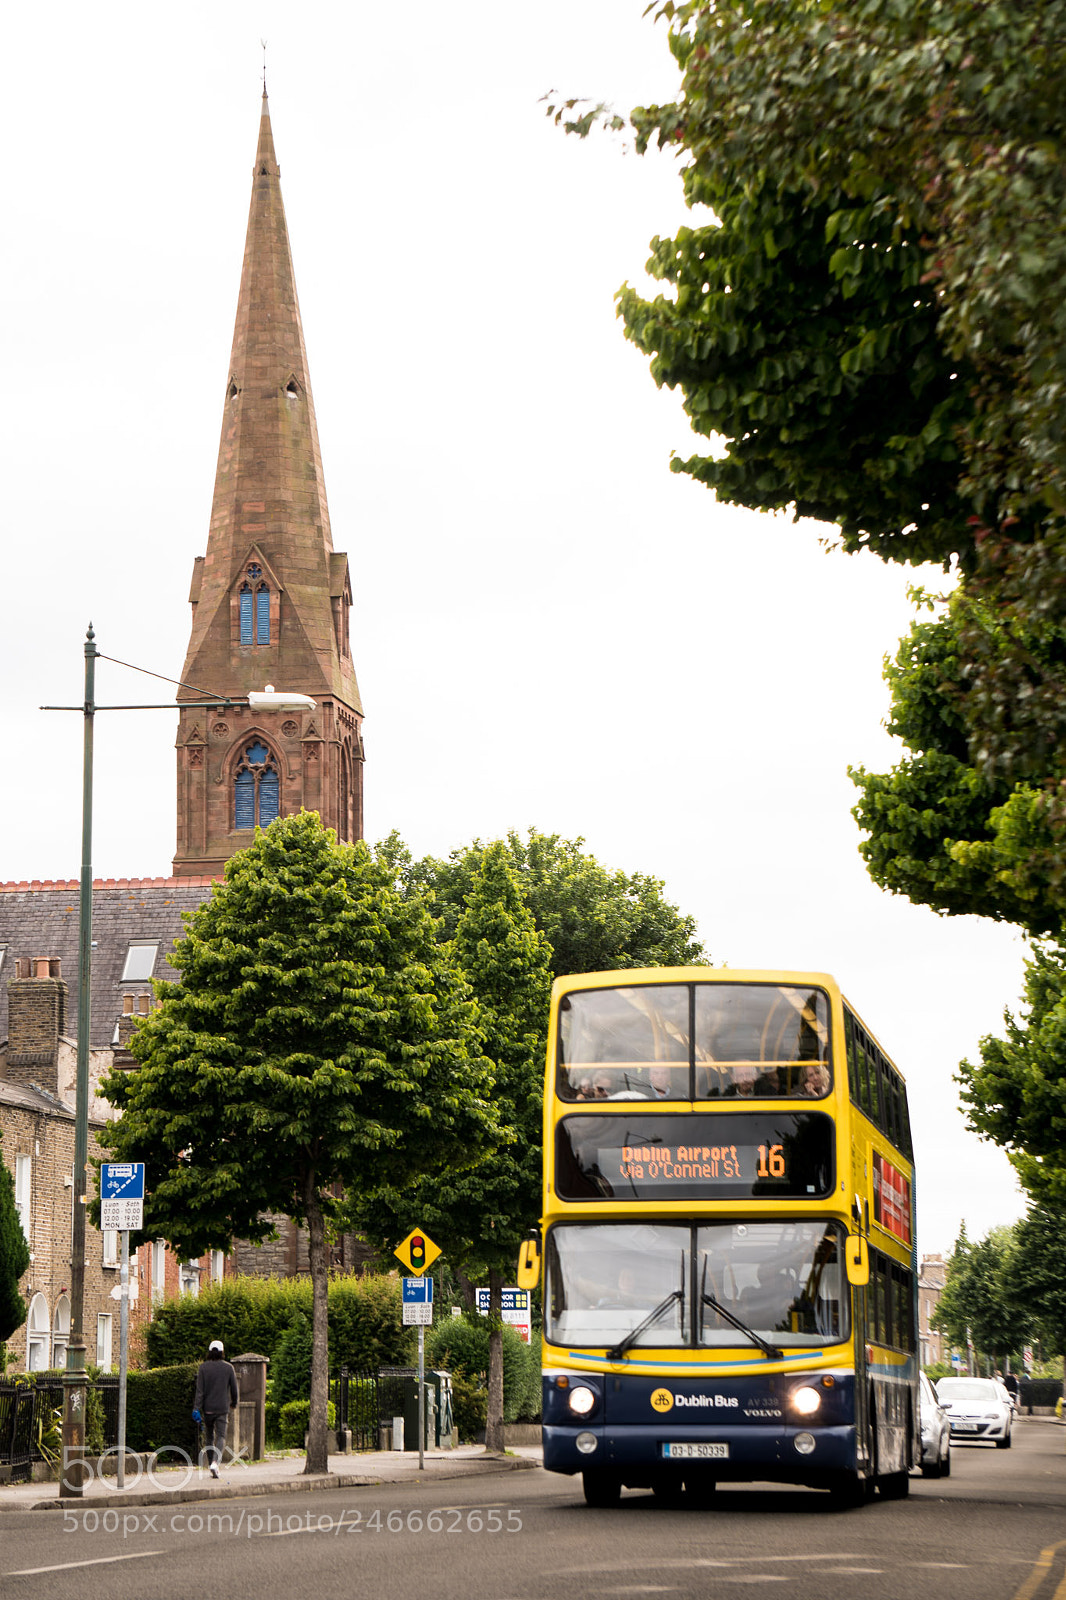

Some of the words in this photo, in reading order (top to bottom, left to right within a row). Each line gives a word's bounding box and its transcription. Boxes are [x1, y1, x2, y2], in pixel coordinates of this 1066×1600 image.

[621, 1146, 671, 1162] Dublin
[677, 1145, 738, 1161] Airport
[757, 1144, 786, 1177] 16
[648, 1161, 719, 1178] O'Connell
[723, 1160, 742, 1177] St
[675, 1395, 713, 1407] Dublin
[714, 1395, 739, 1408] Bus
[743, 1409, 782, 1417] VOLVO
[671, 1444, 725, 1457] 03-D-50339
